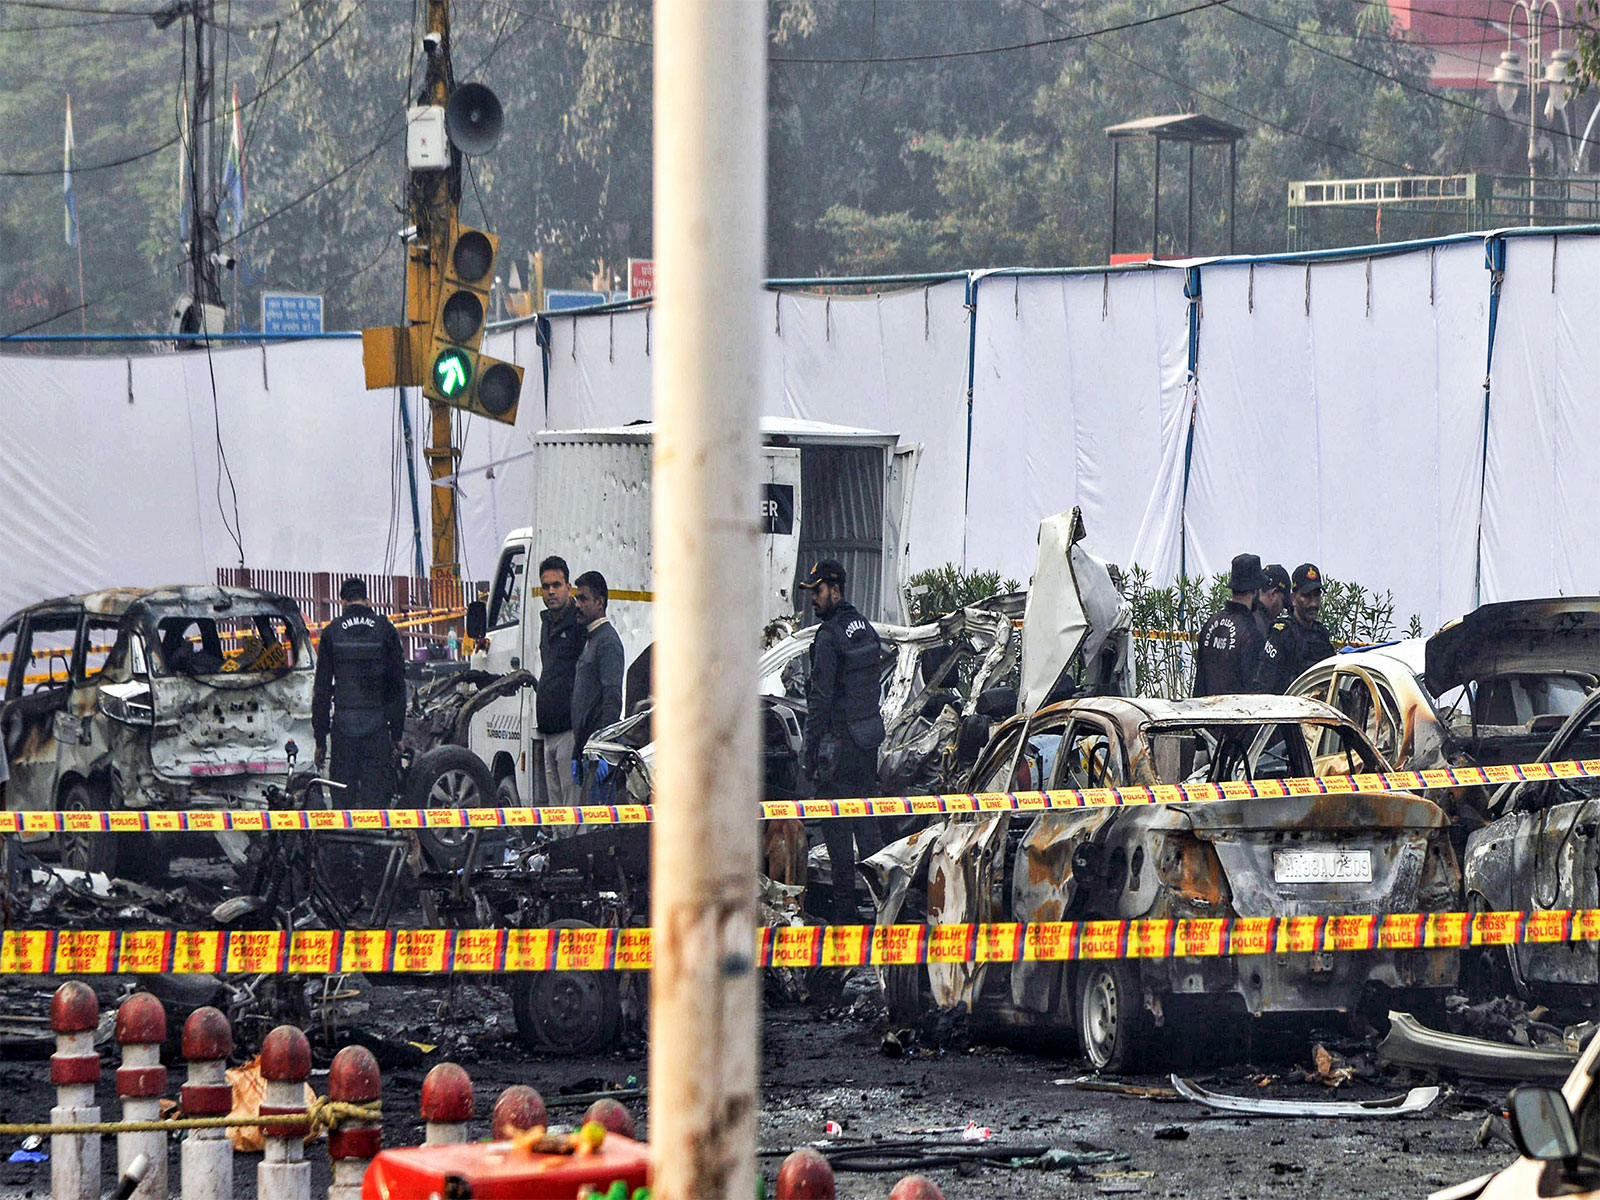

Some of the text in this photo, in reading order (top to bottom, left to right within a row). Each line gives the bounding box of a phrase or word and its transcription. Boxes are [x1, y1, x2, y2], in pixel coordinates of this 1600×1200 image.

[760, 500, 778, 517] ER
[1193, 791, 1210, 799] LINE
[912, 801, 937, 809] POLICE
[1018, 797, 1043, 805] POLICE
[771, 808, 788, 816] LINE
[805, 805, 830, 813] POLICE
[879, 805, 897, 813] LINE
[353, 815, 379, 823] POLICE
[469, 813, 496, 822] POLICE
[583, 811, 609, 819] POLICE
[110, 818, 139, 826] POLICE
[233, 817, 261, 826] POLICE
[1179, 921, 1214, 931] DO NOT
[1328, 917, 1363, 926] DO NOT
[1476, 921, 1506, 931] CROSS
[874, 927, 911, 938] DO NOT
[933, 929, 962, 941] DELHI
[1028, 924, 1063, 935] DO NOT
[1085, 925, 1114, 936] DELHI
[1328, 926, 1359, 936] CROSS
[1527, 926, 1560, 937] POLICE
[59, 934, 100, 945] DO NOT
[231, 934, 270, 945] DO NOT
[397, 933, 436, 944] DO NOT
[560, 932, 598, 943] DO NOT
[620, 935, 650, 946] DELHI
[778, 933, 807, 944] DELHI
[1029, 935, 1060, 946] CROSS
[1180, 931, 1210, 941] CROSS
[1380, 931, 1413, 943] POLICE
[1481, 931, 1502, 942] LINE
[126, 938, 157, 950] DELHI
[295, 938, 327, 950] DELHI
[459, 936, 490, 948] DELHI
[876, 939, 908, 950] CROSS
[1082, 941, 1115, 953] POLICE
[1185, 942, 1206, 953] LINE
[1232, 936, 1265, 948] POLICE
[1333, 938, 1355, 949] LINE
[61, 948, 97, 957] CROSS
[233, 947, 268, 958] CROSS
[400, 946, 433, 956] CROSS
[563, 944, 595, 955] CROSS
[775, 948, 809, 960] POLICE
[930, 945, 963, 957] POLICE
[1034, 947, 1055, 958] LINE
[121, 955, 160, 966] POLICE
[291, 954, 328, 966] POLICE
[456, 952, 492, 965] POLICE
[568, 956, 589, 968] LINE
[617, 951, 653, 963] POLICE
[881, 951, 903, 962] LINE
[66, 960, 91, 970] LINE
[239, 959, 262, 970] LINE
[405, 958, 428, 969] LINE
